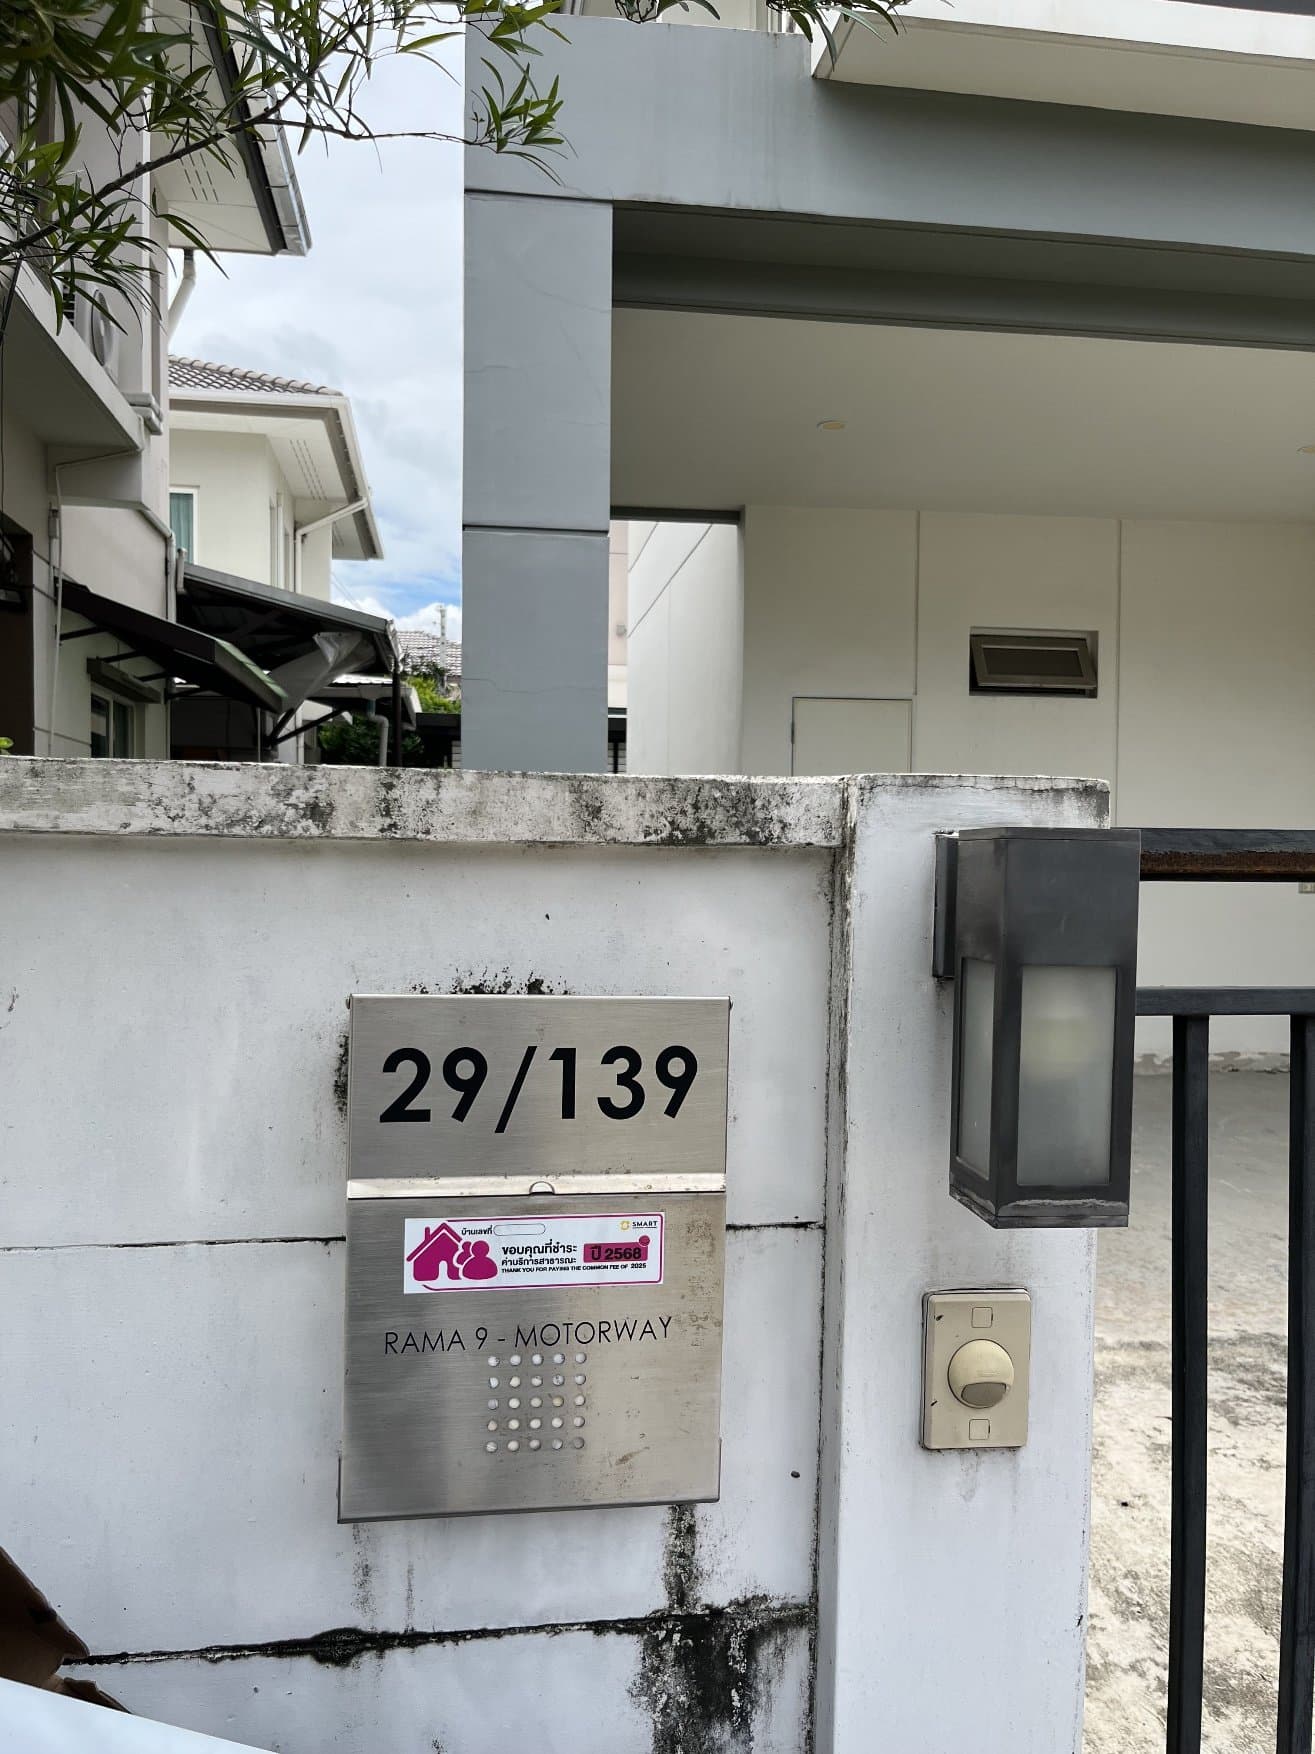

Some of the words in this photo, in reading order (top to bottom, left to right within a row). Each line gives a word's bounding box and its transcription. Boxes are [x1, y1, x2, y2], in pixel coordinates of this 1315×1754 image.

[379, 1046, 698, 1134] 29/139
[461, 1224, 493, 1236] บ้านเลขที่
[501, 1238, 577, 1258] ขอบคุณที่ชำระ
[604, 1247, 642, 1260] 2568
[501, 1257, 576, 1266] ค่าบริการสาธารณะ
[384, 1329, 466, 1355] RAMA
[475, 1327, 488, 1350] 9
[515, 1316, 672, 1348] MOTORWAY
